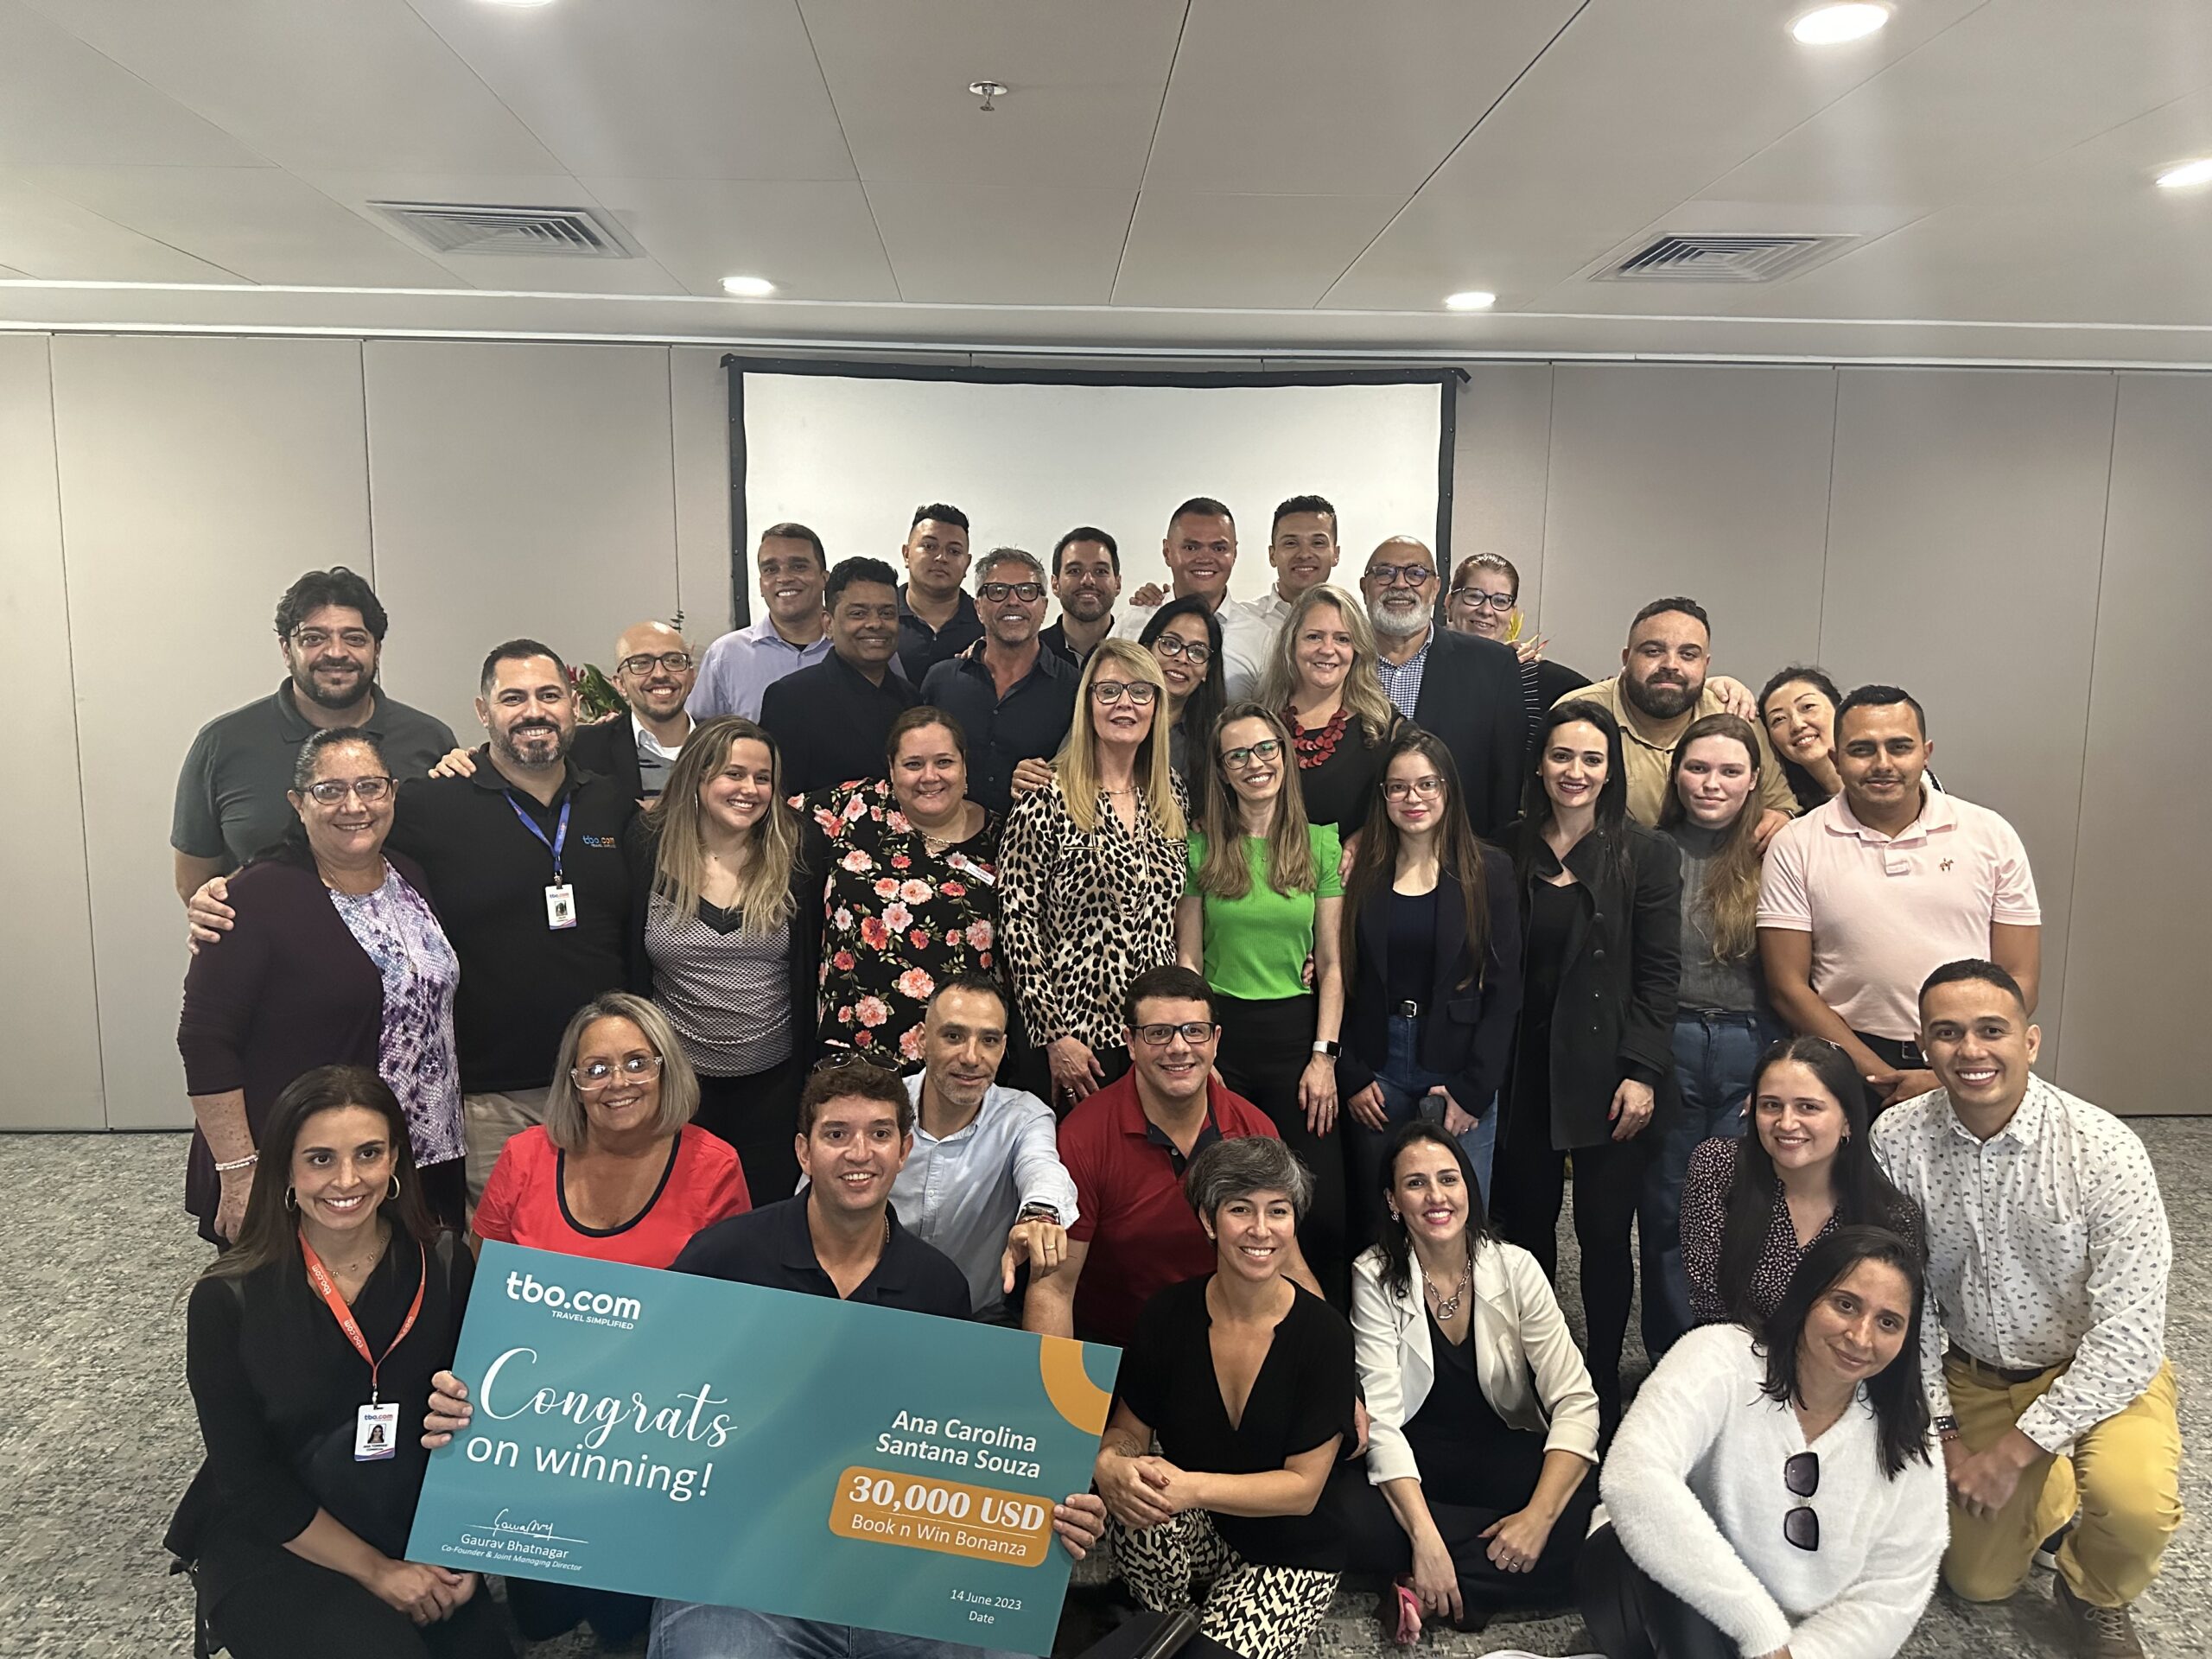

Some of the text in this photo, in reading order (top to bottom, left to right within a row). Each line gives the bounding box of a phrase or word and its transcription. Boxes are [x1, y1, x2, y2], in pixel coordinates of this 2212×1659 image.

[312, 1264, 332, 1295] tbo.com
[506, 1271, 641, 1320] tbo.com
[343, 1319, 364, 1349] tbo.com
[551, 1310, 634, 1330] TRAVEL SIMPLIFIED
[480, 1347, 738, 1450] Congrats
[892, 1410, 1037, 1452] Ana Carolina
[466, 1435, 713, 1502] on winning!
[875, 1433, 1040, 1479] Santana Souza
[849, 1475, 1046, 1531] 30,000 USD
[461, 1534, 569, 1559] Gaurav Bhatnagar
[851, 1514, 1027, 1557] Book n Win Bonanza
[442, 1544, 485, 1558] Co-Founder
[493, 1552, 512, 1561] Joint
[513, 1554, 550, 1568] Managing
[551, 1560, 582, 1572] Director
[950, 1589, 1022, 1611] 14 June 2023
[969, 1611, 995, 1624] Date
